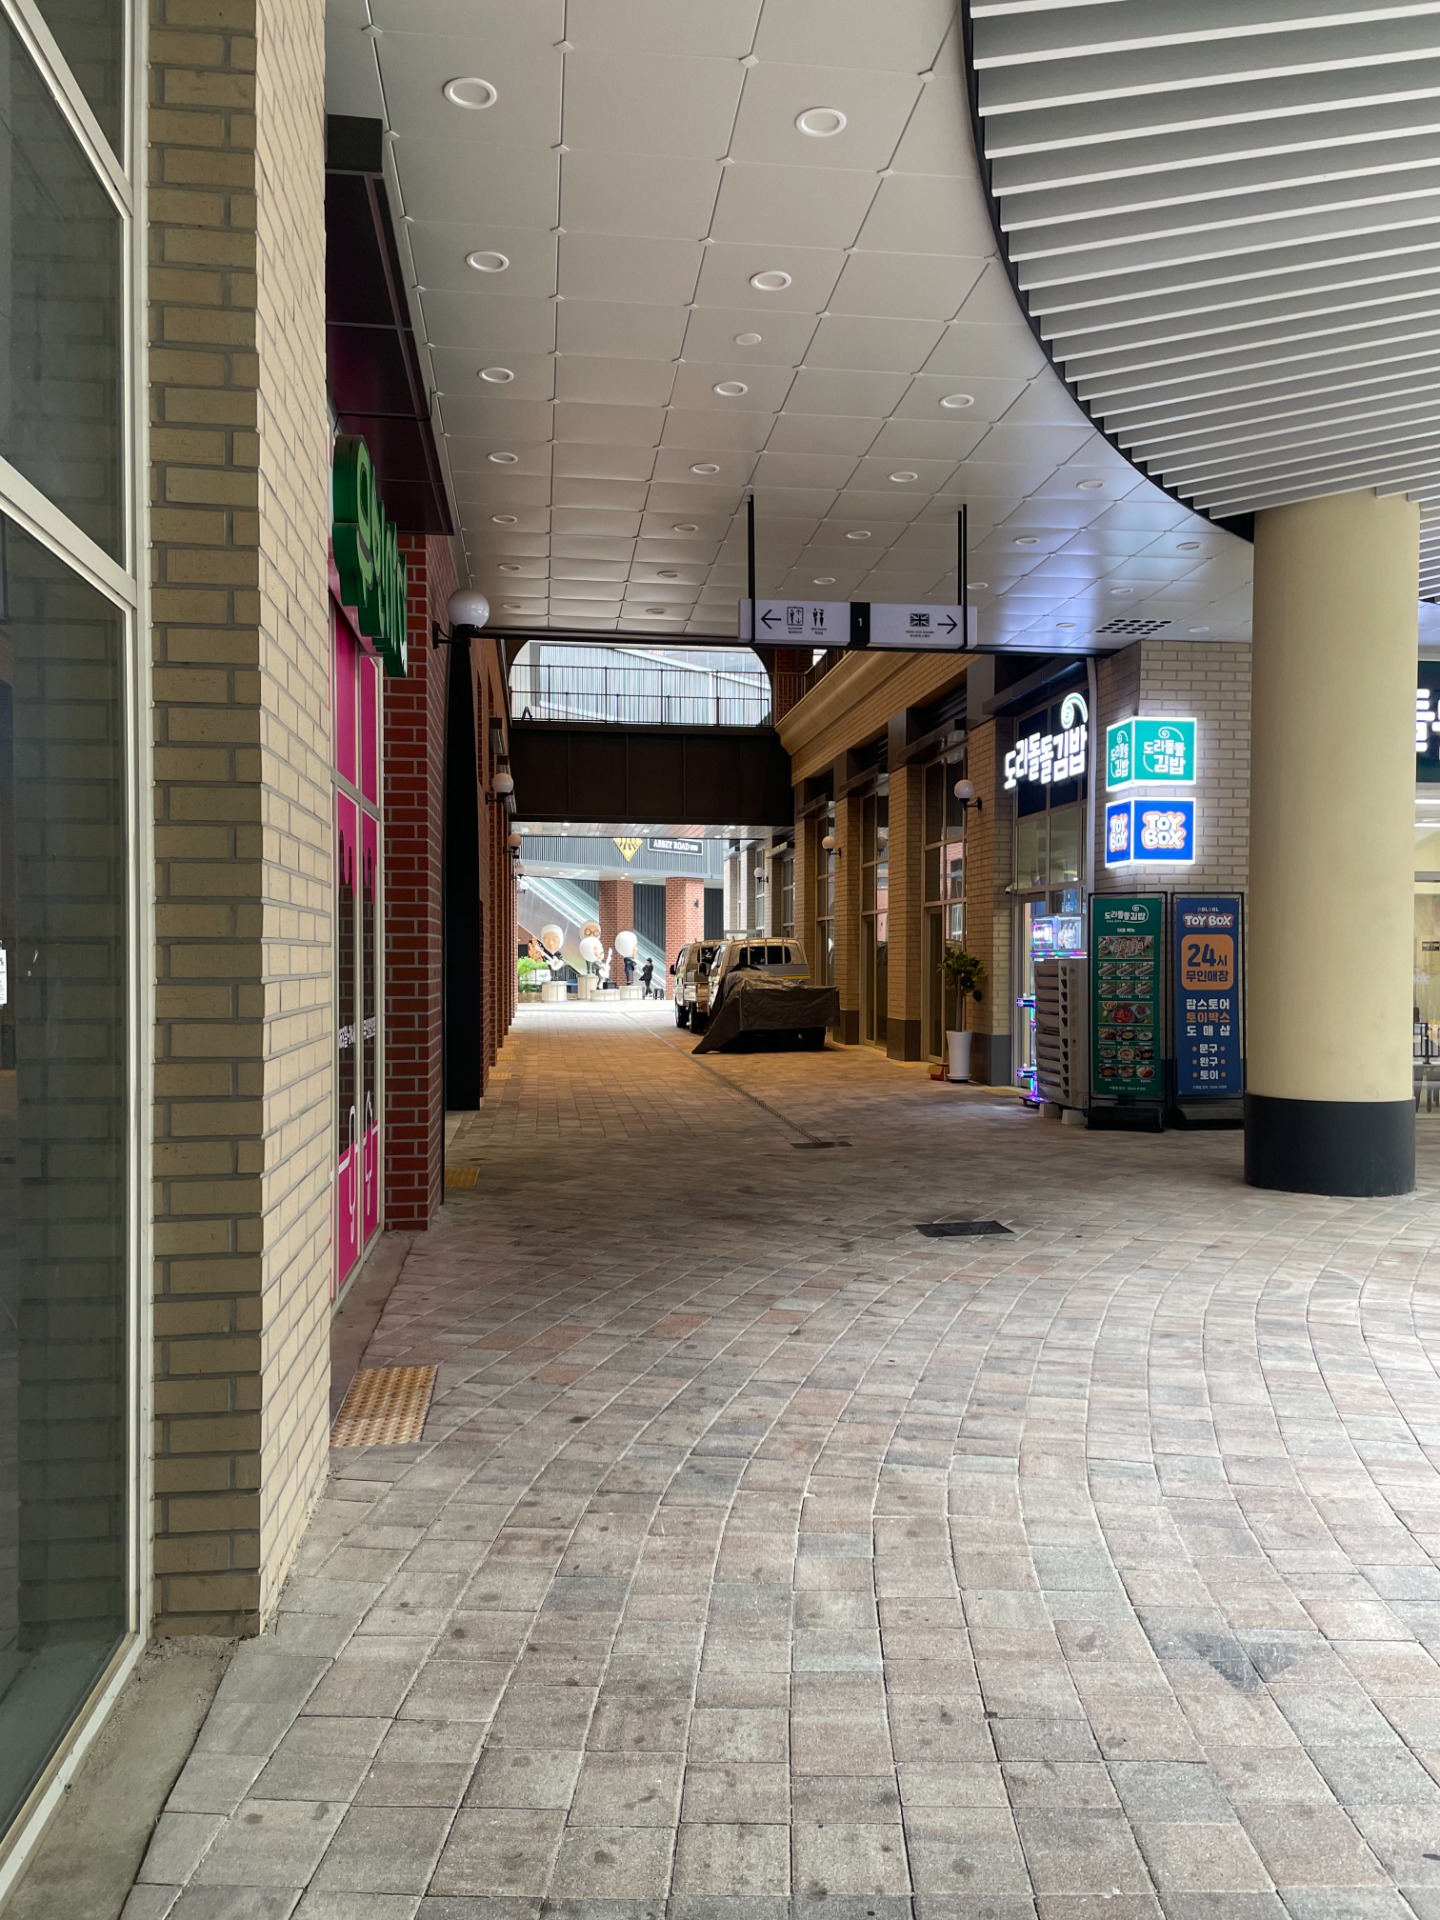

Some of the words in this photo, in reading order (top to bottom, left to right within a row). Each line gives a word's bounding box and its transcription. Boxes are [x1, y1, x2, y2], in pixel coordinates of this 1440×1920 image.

[857, 617, 863, 627] 1
[1003, 723, 1088, 790] 도리돌돌김밥
[1115, 759, 1130, 778] 김밥
[1153, 754, 1186, 775] 김밥
[1111, 815, 1128, 833] TOY
[1145, 814, 1183, 830] TOY
[1110, 831, 1128, 850] BOX
[1144, 829, 1183, 846] BOX
[653, 839, 672, 850] ABBEY
[673, 841, 690, 851] ROAD
[1184, 915, 1206, 926] TOY
[1208, 915, 1232, 926] BOX
[1187, 943, 1228, 967] 24시
[1185, 969, 1229, 982] 무인매장
[1185, 998, 1230, 1010] 팝스토어
[1186, 1011, 1230, 1023] 토이박스
[1199, 1043, 1218, 1054] 문구
[1199, 1056, 1218, 1067] 완구
[1200, 1069, 1219, 1080] 토이
